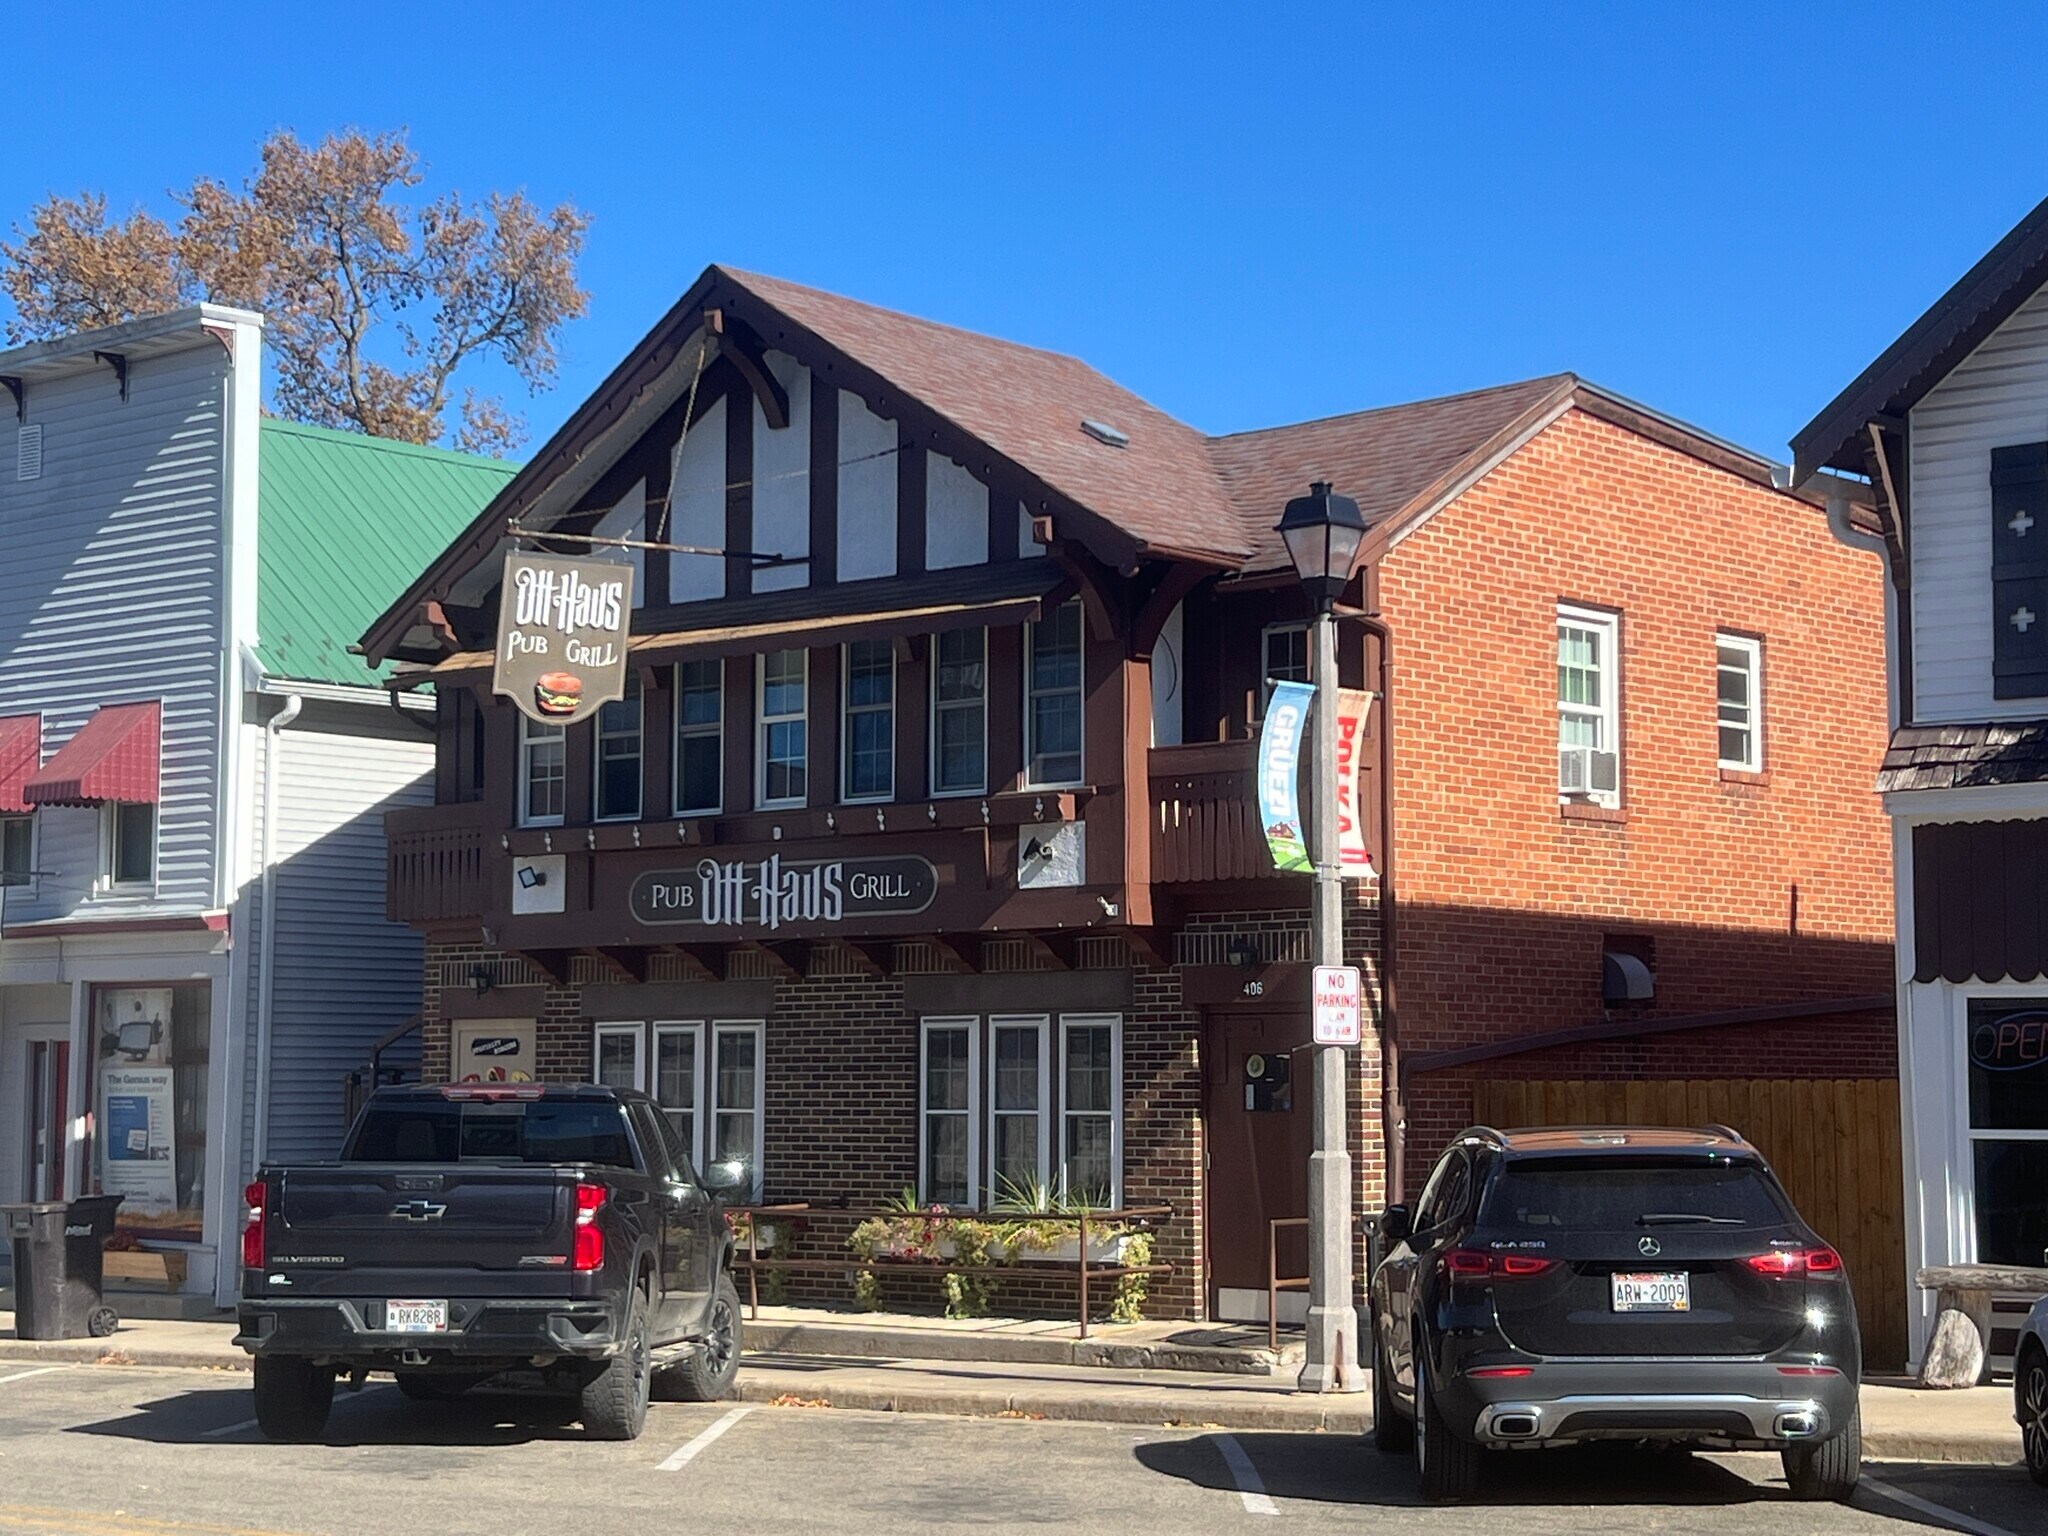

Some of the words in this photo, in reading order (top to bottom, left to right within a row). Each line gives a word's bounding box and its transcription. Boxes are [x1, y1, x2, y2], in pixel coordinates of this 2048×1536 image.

[552, 570, 623, 635] Haus
[751, 853, 843, 930] Haus
[1243, 981, 1264, 995] 406
[1328, 975, 1345, 988] NO
[1317, 993, 1356, 1008] PARKING
[107, 1074, 122, 1084] The
[152, 1076, 168, 1086] way
[1616, 1284, 1685, 1302] ARW-2009
